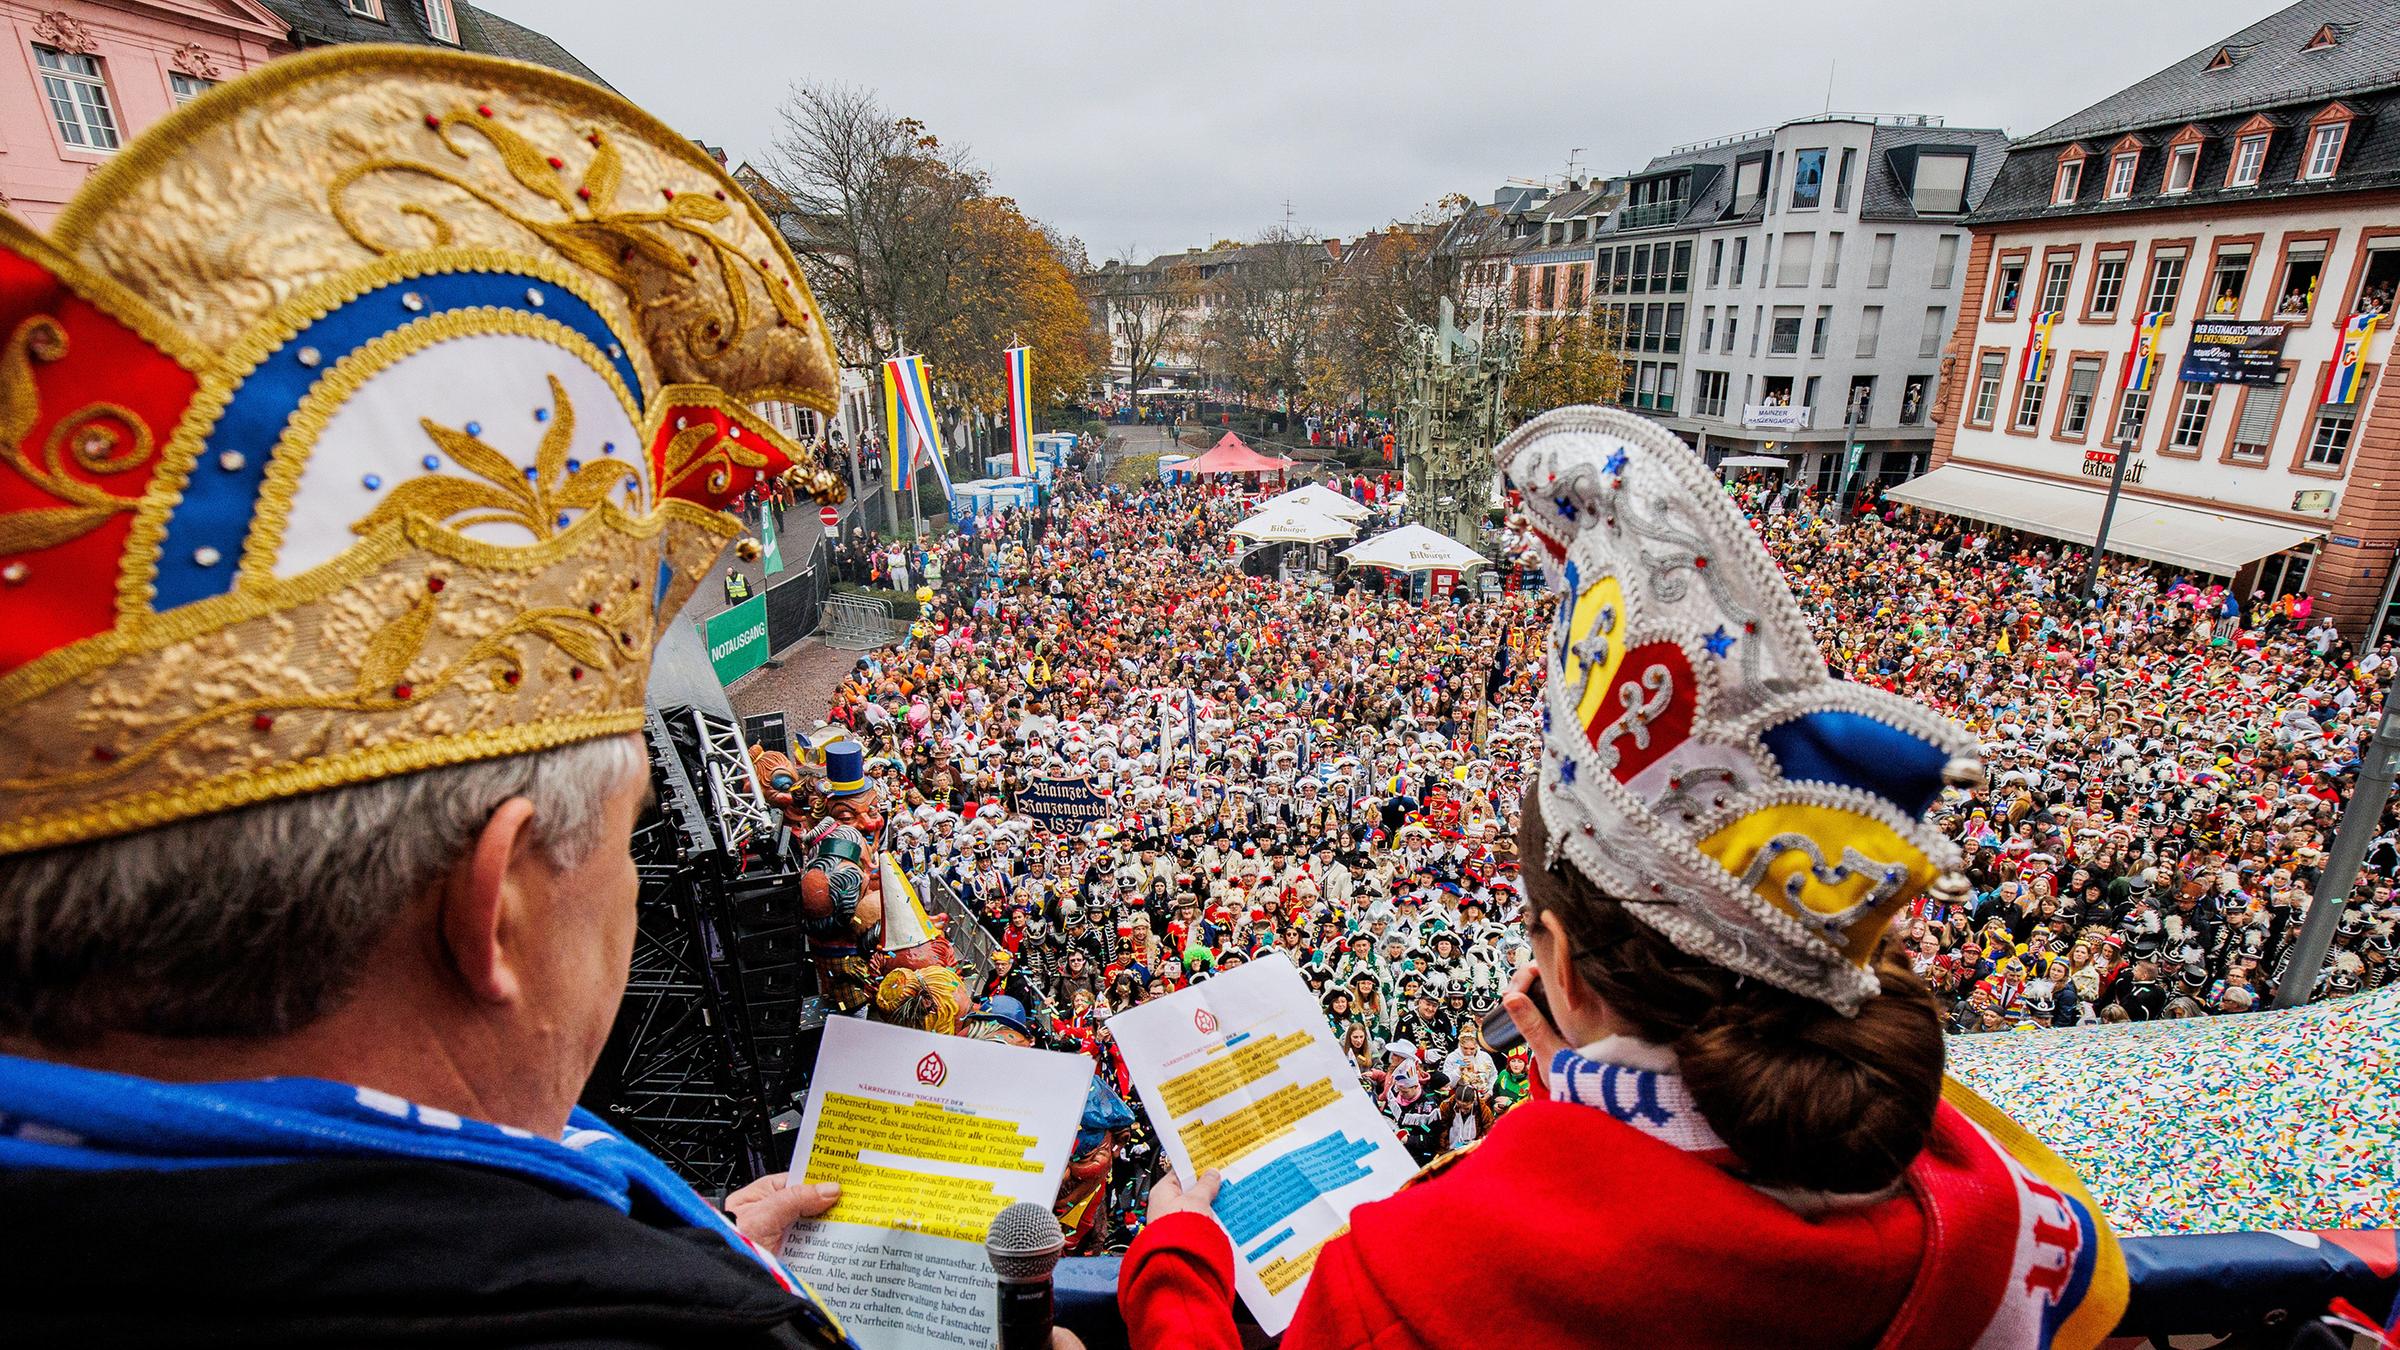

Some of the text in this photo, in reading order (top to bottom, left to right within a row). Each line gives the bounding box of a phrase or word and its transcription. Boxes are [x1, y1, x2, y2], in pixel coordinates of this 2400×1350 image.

[2193, 334, 2248, 345] DU ENTSCHEIDEST!
[2195, 324, 2207, 334] DER
[2207, 325, 2263, 335] FASTNACHTS-SONG
[1758, 409, 1789, 417] MAINZER
[2082, 458, 2147, 484] extraatt
[1270, 523, 1308, 534] Bitburger
[1409, 550, 1452, 561] Bitburger
[711, 621, 766, 663] NOTAUSGANG
[1032, 781, 1089, 800] Mainzer
[1049, 817, 1084, 833] 1837
[820, 1105, 1038, 1148] Grundgesetz, dass ausdrücklich für alle Geschlechter
[824, 1093, 891, 1114] Vorbemerkung:
[893, 1105, 909, 1115] Wir
[910, 1108, 944, 1122] verlesen
[945, 1114, 964, 1127] jetzt
[965, 1117, 980, 1127] das
[811, 1142, 859, 1160] Präambel
[814, 1131, 854, 1147] sprechen
[855, 1138, 871, 1148] wir
[871, 1141, 884, 1150] im
[886, 1143, 946, 1161] Nachfolgenden
[947, 1153, 962, 1163] nur
[981, 1158, 997, 1168] von
[998, 1159, 1014, 1169] den
[1016, 1161, 1044, 1174] Narren
[816, 1117, 1025, 1159] gilt, aber wegen der Verständlichkeit und Tradition
[804, 1169, 867, 1188] nachfolgenden
[938, 1188, 951, 1200] für
[951, 1190, 968, 1201] alle
[969, 1192, 1000, 1206] Narren,
[808, 1156, 840, 1170] Unsere
[841, 1162, 874, 1177] goldige
[875, 1167, 907, 1181] Mainzer
[948, 1177, 963, 1188] soll
[964, 1180, 977, 1190] für
[978, 1182, 994, 1192] alle
[791, 1219, 820, 1233] Artikel
[930, 1224, 951, 1237] auch
[952, 1228, 973, 1240] feste
[782, 1246, 996, 1289] Mainzer Bürger ist zur Erhaltung der Narrenfreihe
[786, 1233, 802, 1244] Die
[804, 1235, 830, 1248] Würde
[831, 1239, 853, 1251] eines
[853, 1241, 879, 1256] jeden
[881, 1245, 912, 1259] Narren
[913, 1251, 923, 1260] ist
[924, 1253, 978, 1270] unantastbar.
[816, 1279, 834, 1292] und
[835, 1282, 850, 1294] bei
[852, 1284, 868, 1296] der
[870, 1285, 940, 1310] Stadtverwaltung
[940, 1300, 967, 1314] haben
[968, 1305, 985, 1318] das
[825, 1266, 849, 1280] Alle,
[850, 1269, 873, 1282] auch
[874, 1274, 906, 1287] unsere
[907, 1277, 943, 1294] Beamten
[943, 1285, 958, 1297] bei
[959, 1288, 977, 1301] den
[849, 1300, 860, 1309] zu
[863, 1299, 904, 1316] erhalten,
[905, 1306, 925, 1319] denn
[925, 1311, 939, 1322] die
[939, 1314, 992, 1334] Fastnachter
[854, 1312, 904, 1331] Narrheiten
[924, 1326, 967, 1345] bezahlen,
[967, 1335, 988, 1348] weil
